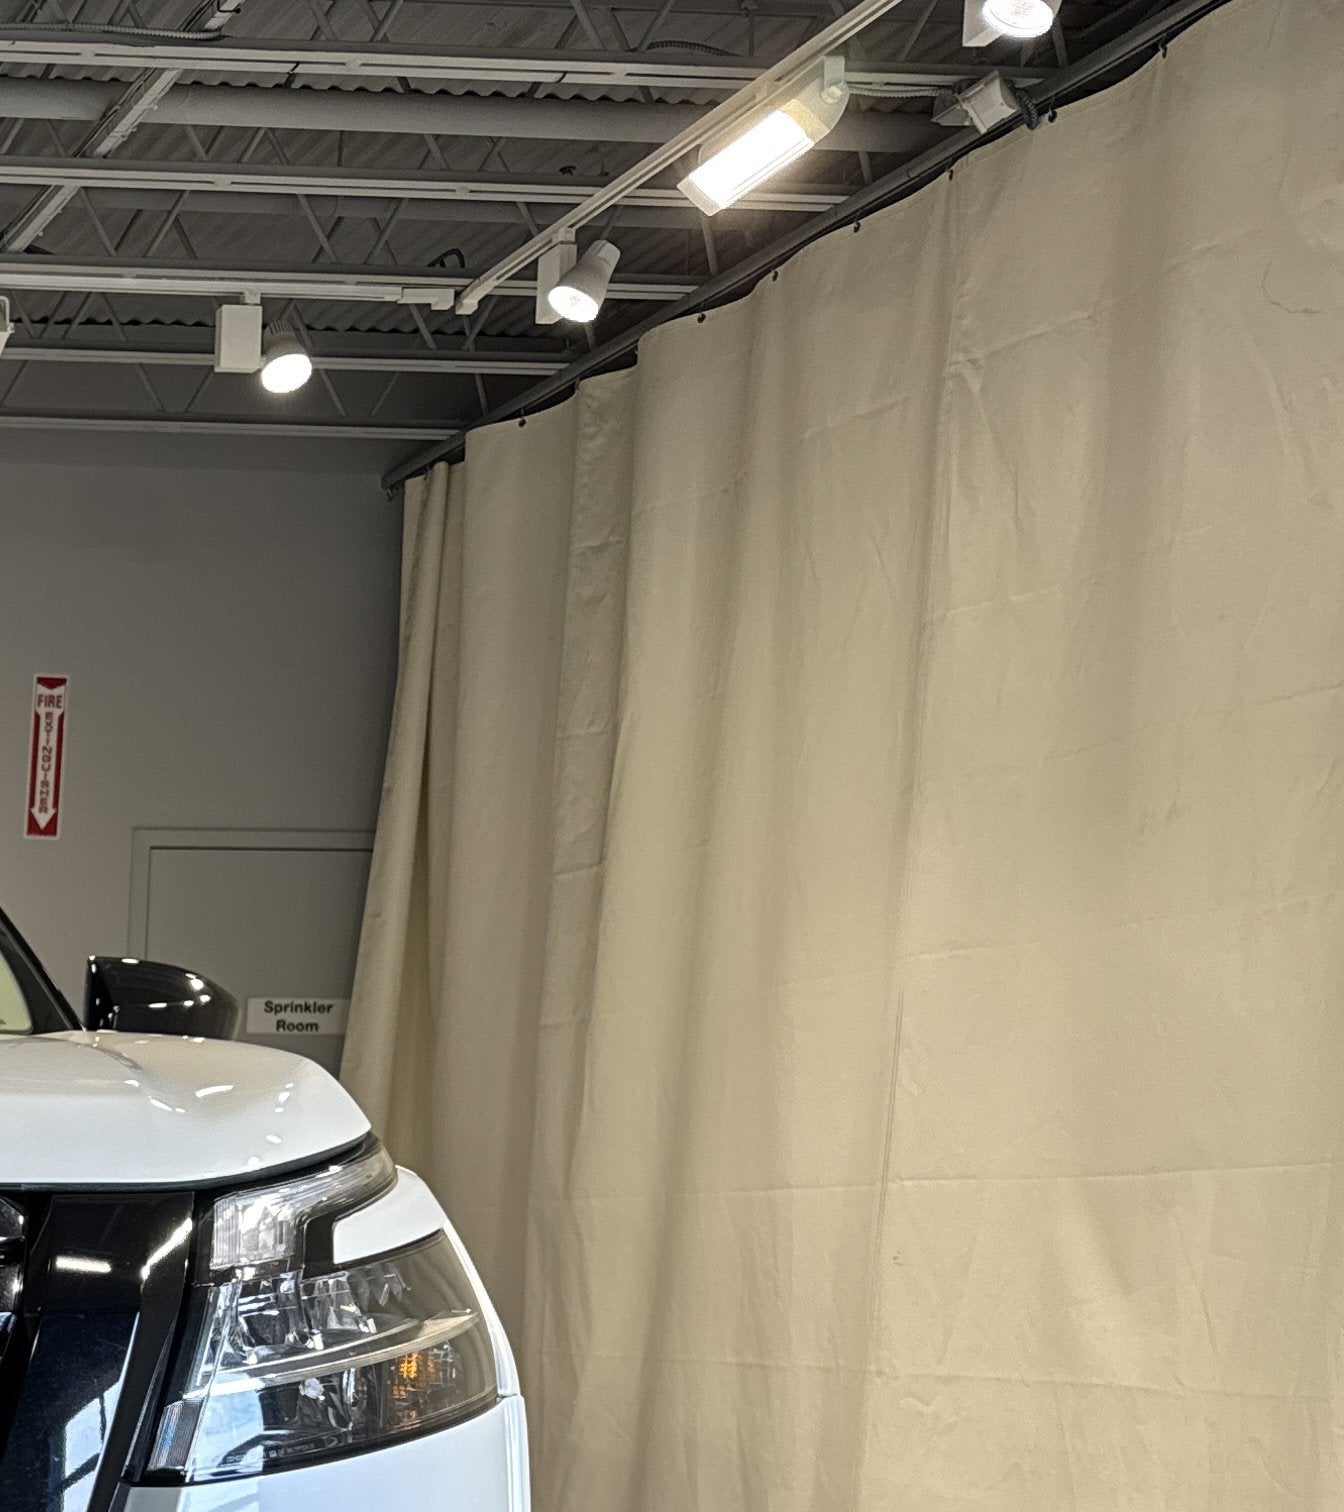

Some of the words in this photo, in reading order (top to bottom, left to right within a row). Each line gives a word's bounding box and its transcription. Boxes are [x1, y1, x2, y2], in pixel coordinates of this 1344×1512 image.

[37, 694, 62, 708] FIRE
[264, 1001, 333, 1015] Sprinkler
[276, 1019, 319, 1032] Room
